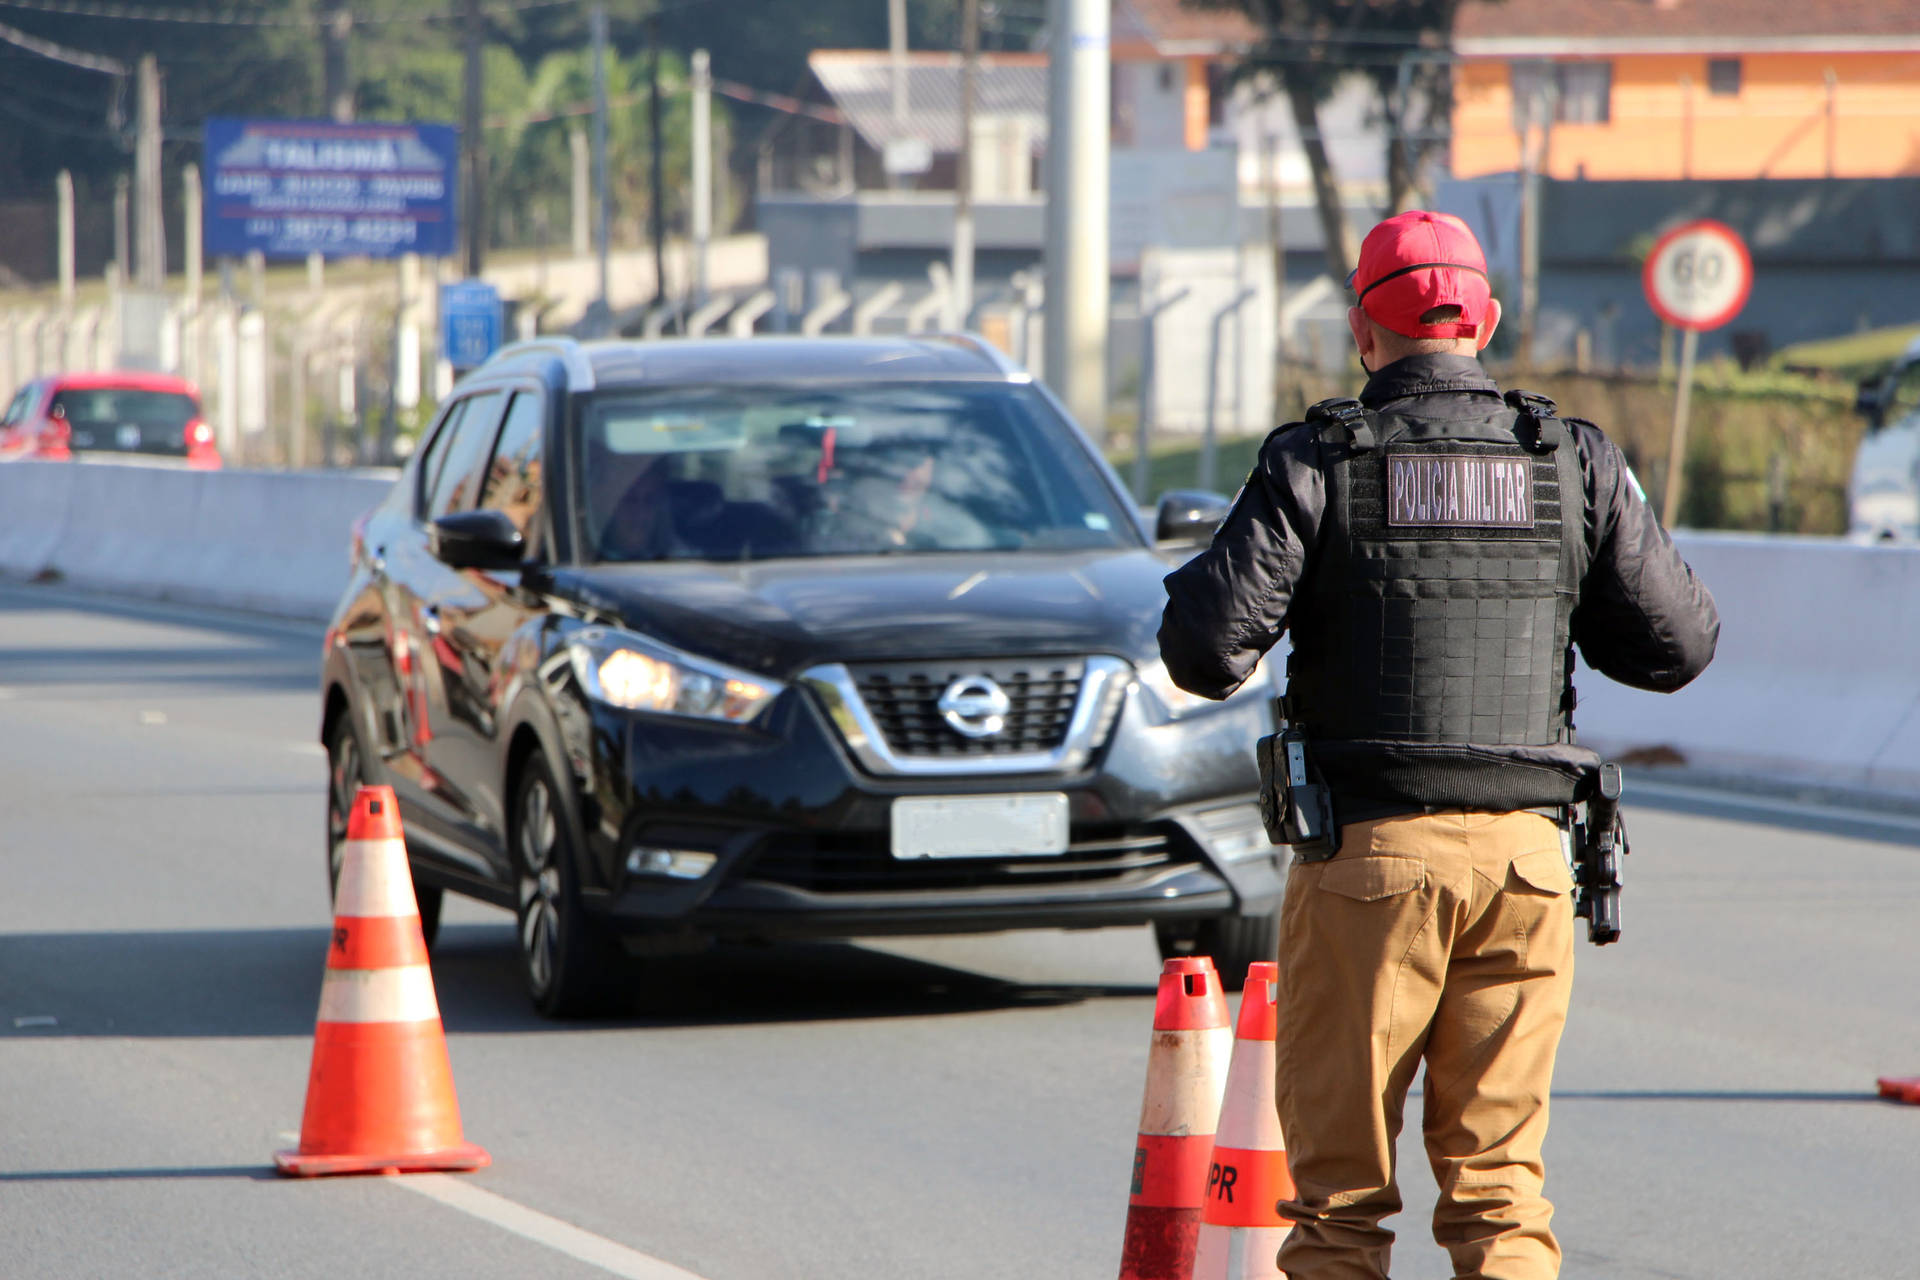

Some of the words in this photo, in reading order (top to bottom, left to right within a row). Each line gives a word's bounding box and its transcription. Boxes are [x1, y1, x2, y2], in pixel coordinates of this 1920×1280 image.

[1673, 250, 1724, 288] 60
[1393, 460, 1460, 522] POLICIA
[1463, 461, 1527, 523] MILITAR
